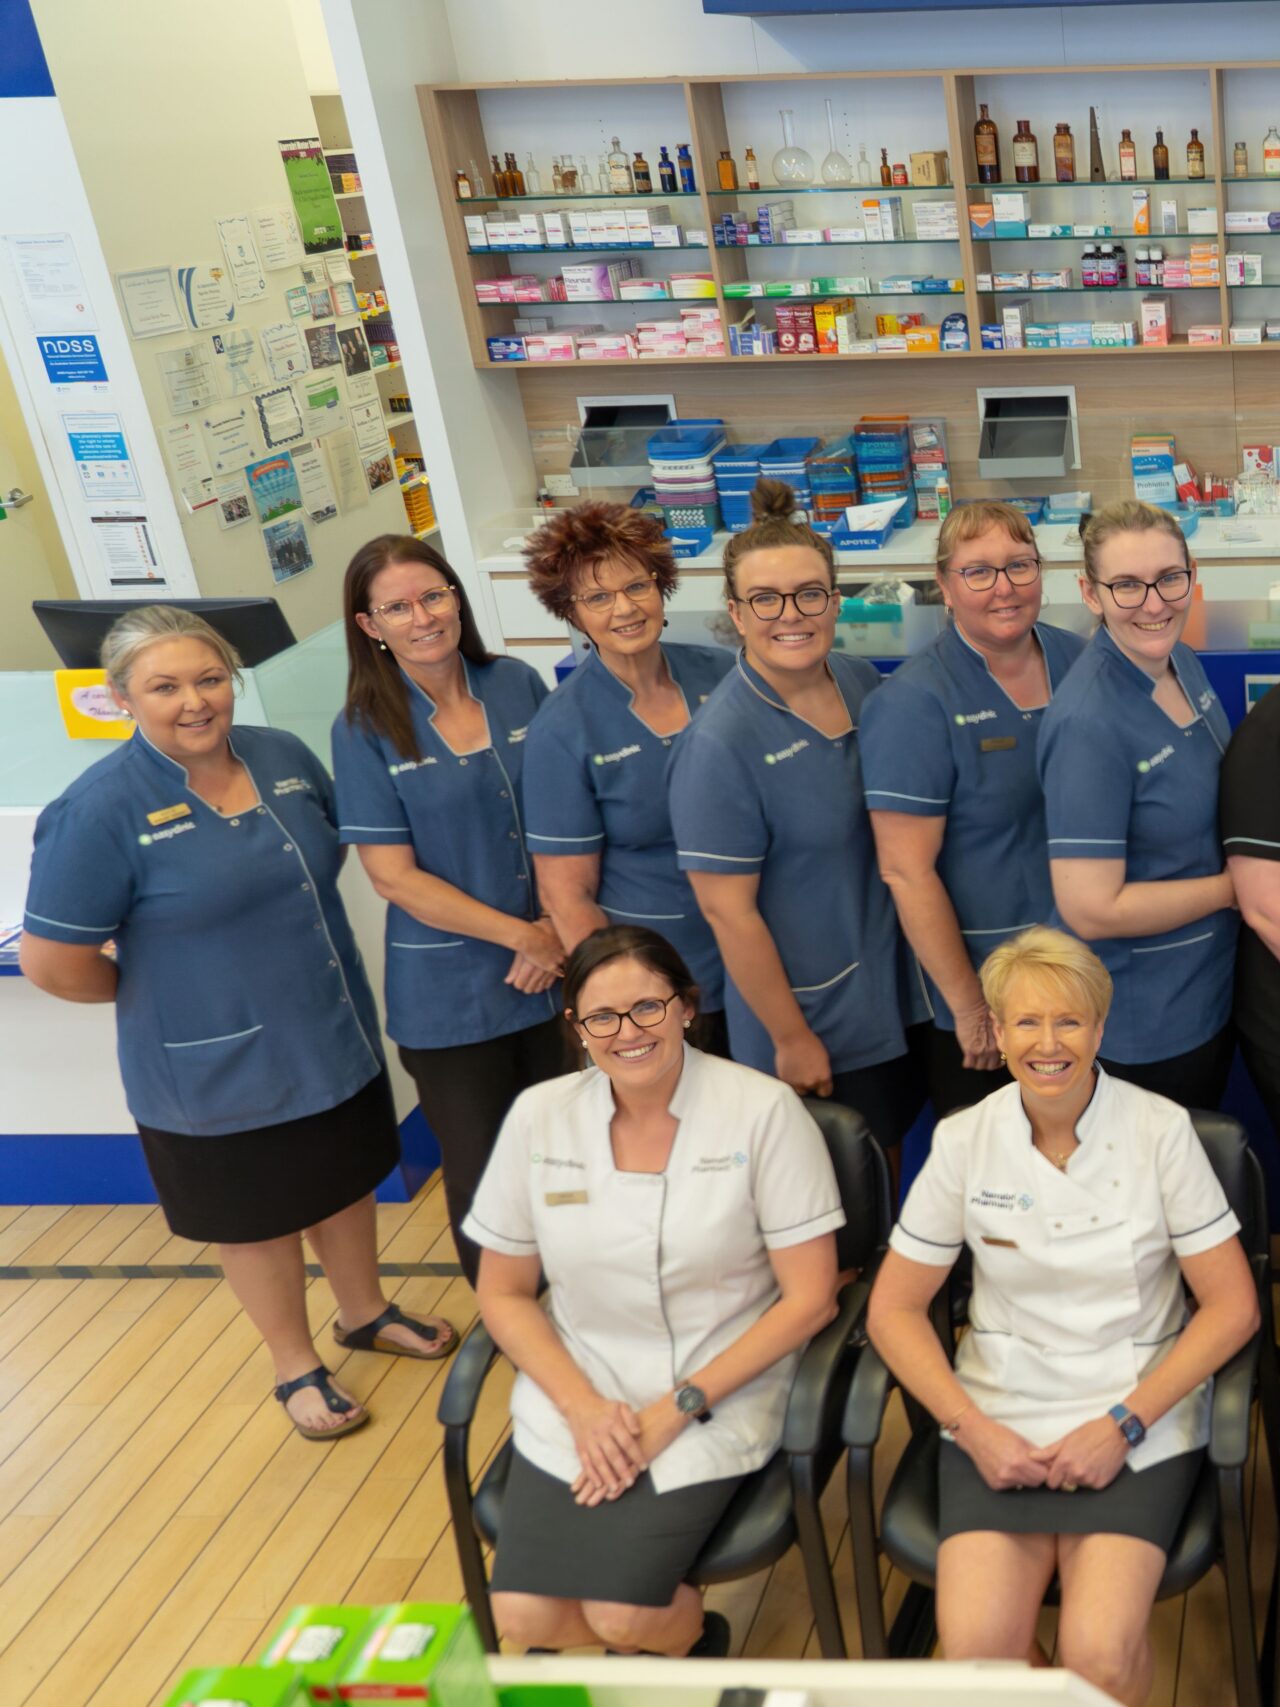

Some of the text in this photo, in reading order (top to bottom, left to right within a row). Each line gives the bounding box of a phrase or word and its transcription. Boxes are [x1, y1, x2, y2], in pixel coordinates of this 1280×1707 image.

[1137, 480, 1170, 488] Probiotics
[839, 538, 877, 546] APOTEX
[981, 1189, 1016, 1201] Narrabri
[971, 1197, 1014, 1211] Pharmacy
